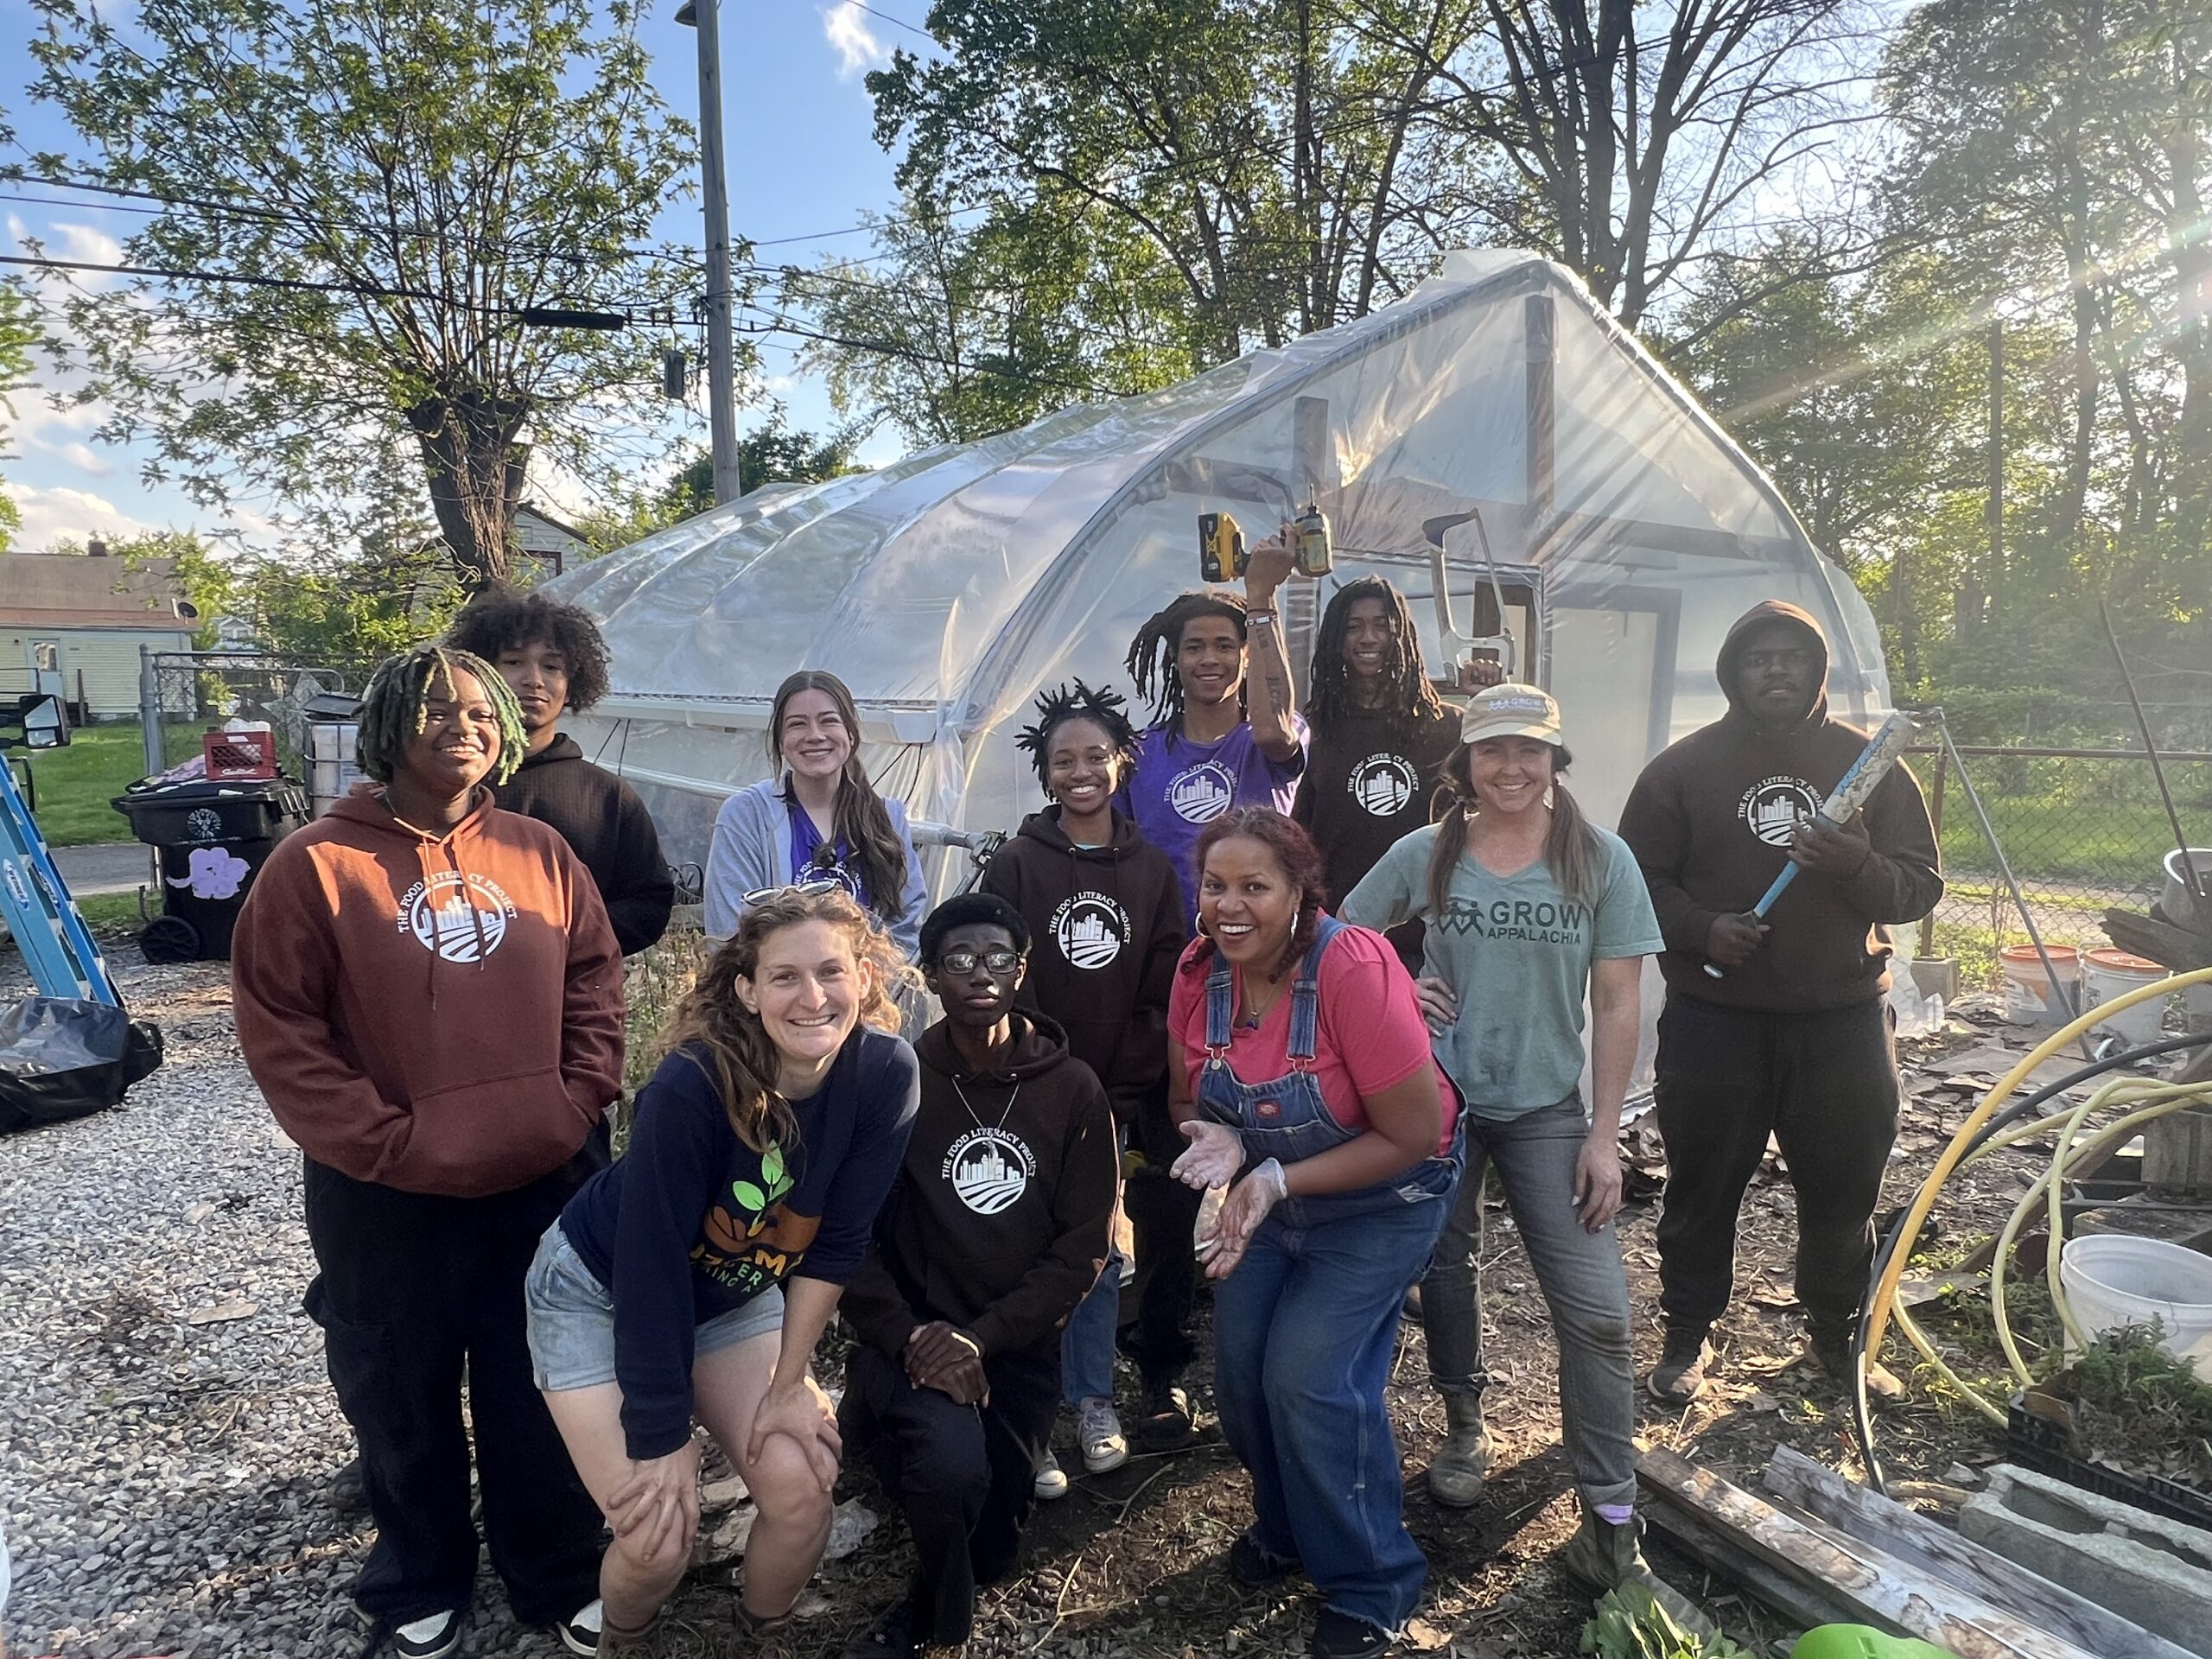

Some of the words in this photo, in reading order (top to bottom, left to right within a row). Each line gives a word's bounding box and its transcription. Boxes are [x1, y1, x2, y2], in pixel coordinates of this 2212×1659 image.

[1367, 753, 1404, 763] LITERCY
[1402, 761, 1420, 791] PROJECT
[401, 880, 424, 908] FOOD
[484, 879, 518, 919] PROJECT
[397, 909, 410, 934] THE
[1048, 914, 1060, 935] THE
[1077, 891, 1118, 908] LITERACY
[1489, 900, 1582, 931] GROW
[1486, 927, 1581, 946] APPALACHIA
[941, 1157, 953, 1180] THE
[947, 1134, 969, 1158] FOOD
[969, 1128, 1020, 1145] LITERACY
